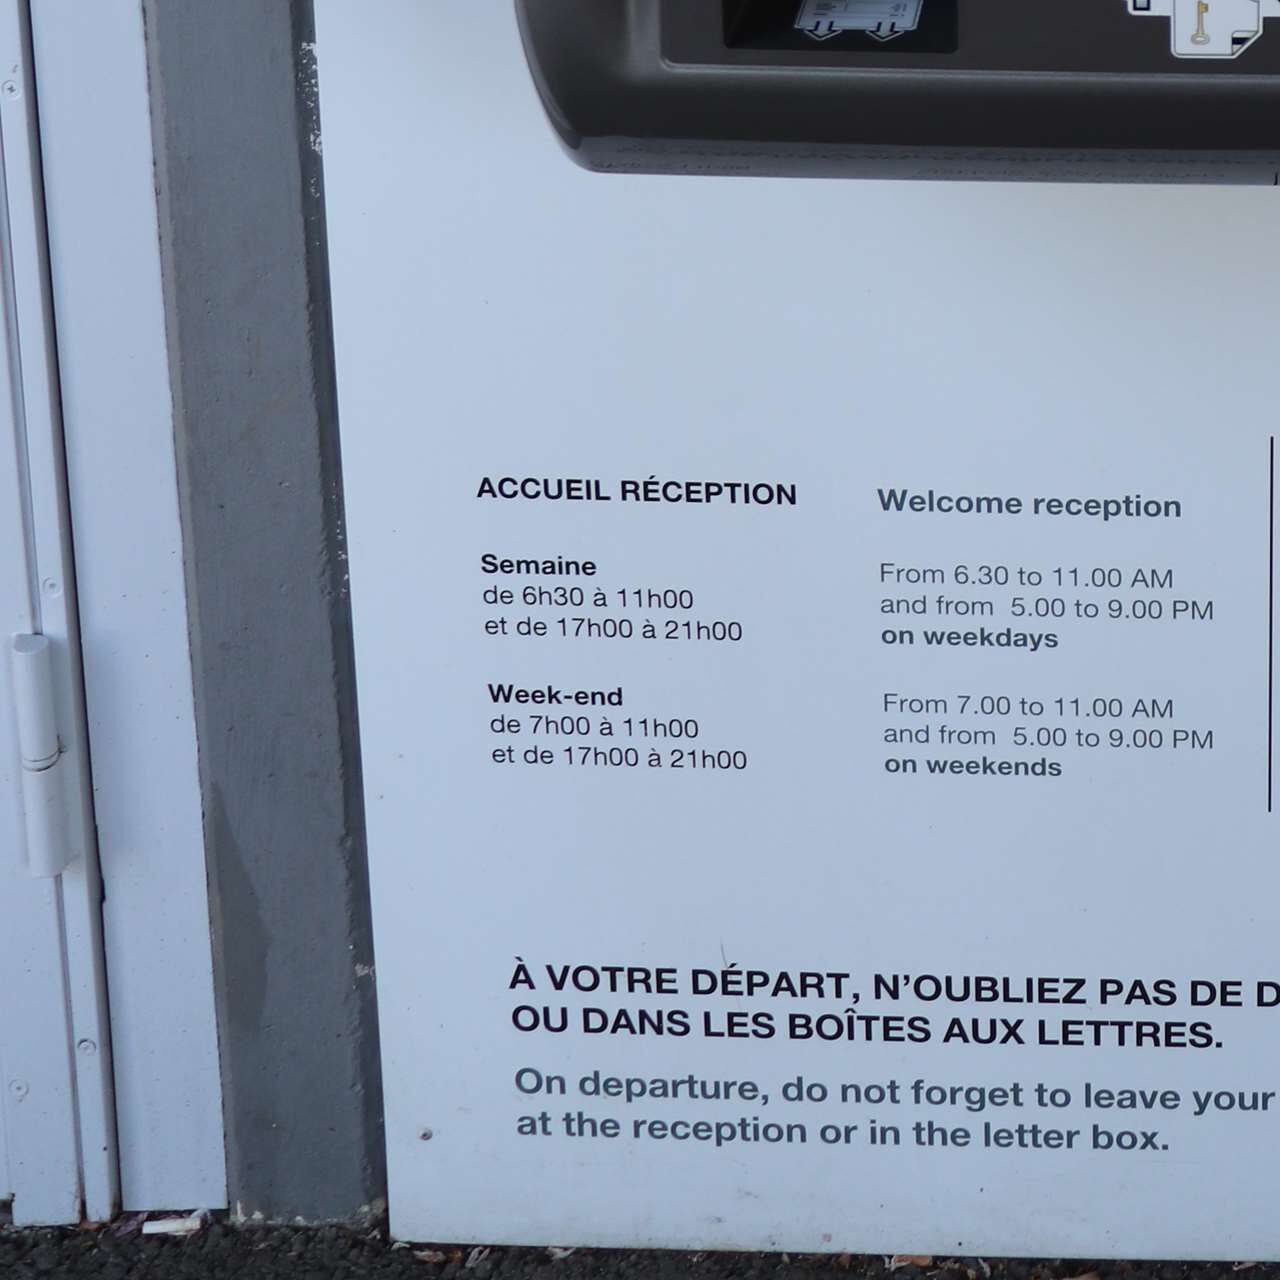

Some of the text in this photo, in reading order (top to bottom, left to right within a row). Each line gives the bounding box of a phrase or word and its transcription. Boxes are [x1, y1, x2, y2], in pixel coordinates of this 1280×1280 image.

[477, 476, 796, 505] ACCUEIL RÉCEPTION
[878, 489, 1181, 521] Welcome reception
[482, 554, 596, 576] Semaine
[483, 585, 693, 609] de 6h30 à 11h00
[882, 627, 1058, 652] on weekdays
[488, 684, 622, 706] Week-end
[885, 756, 1062, 776] on weekends
[509, 958, 535, 989] À
[546, 965, 678, 994] VOTRE
[692, 964, 859, 1004] DÉPART,
[875, 974, 1086, 1004] N'OUBLIEZ
[1100, 979, 1177, 1006] PAS
[1191, 981, 1242, 1006] DE
[512, 1005, 1222, 1048] OU DANS LES BOÎTES AUX LETTRES.
